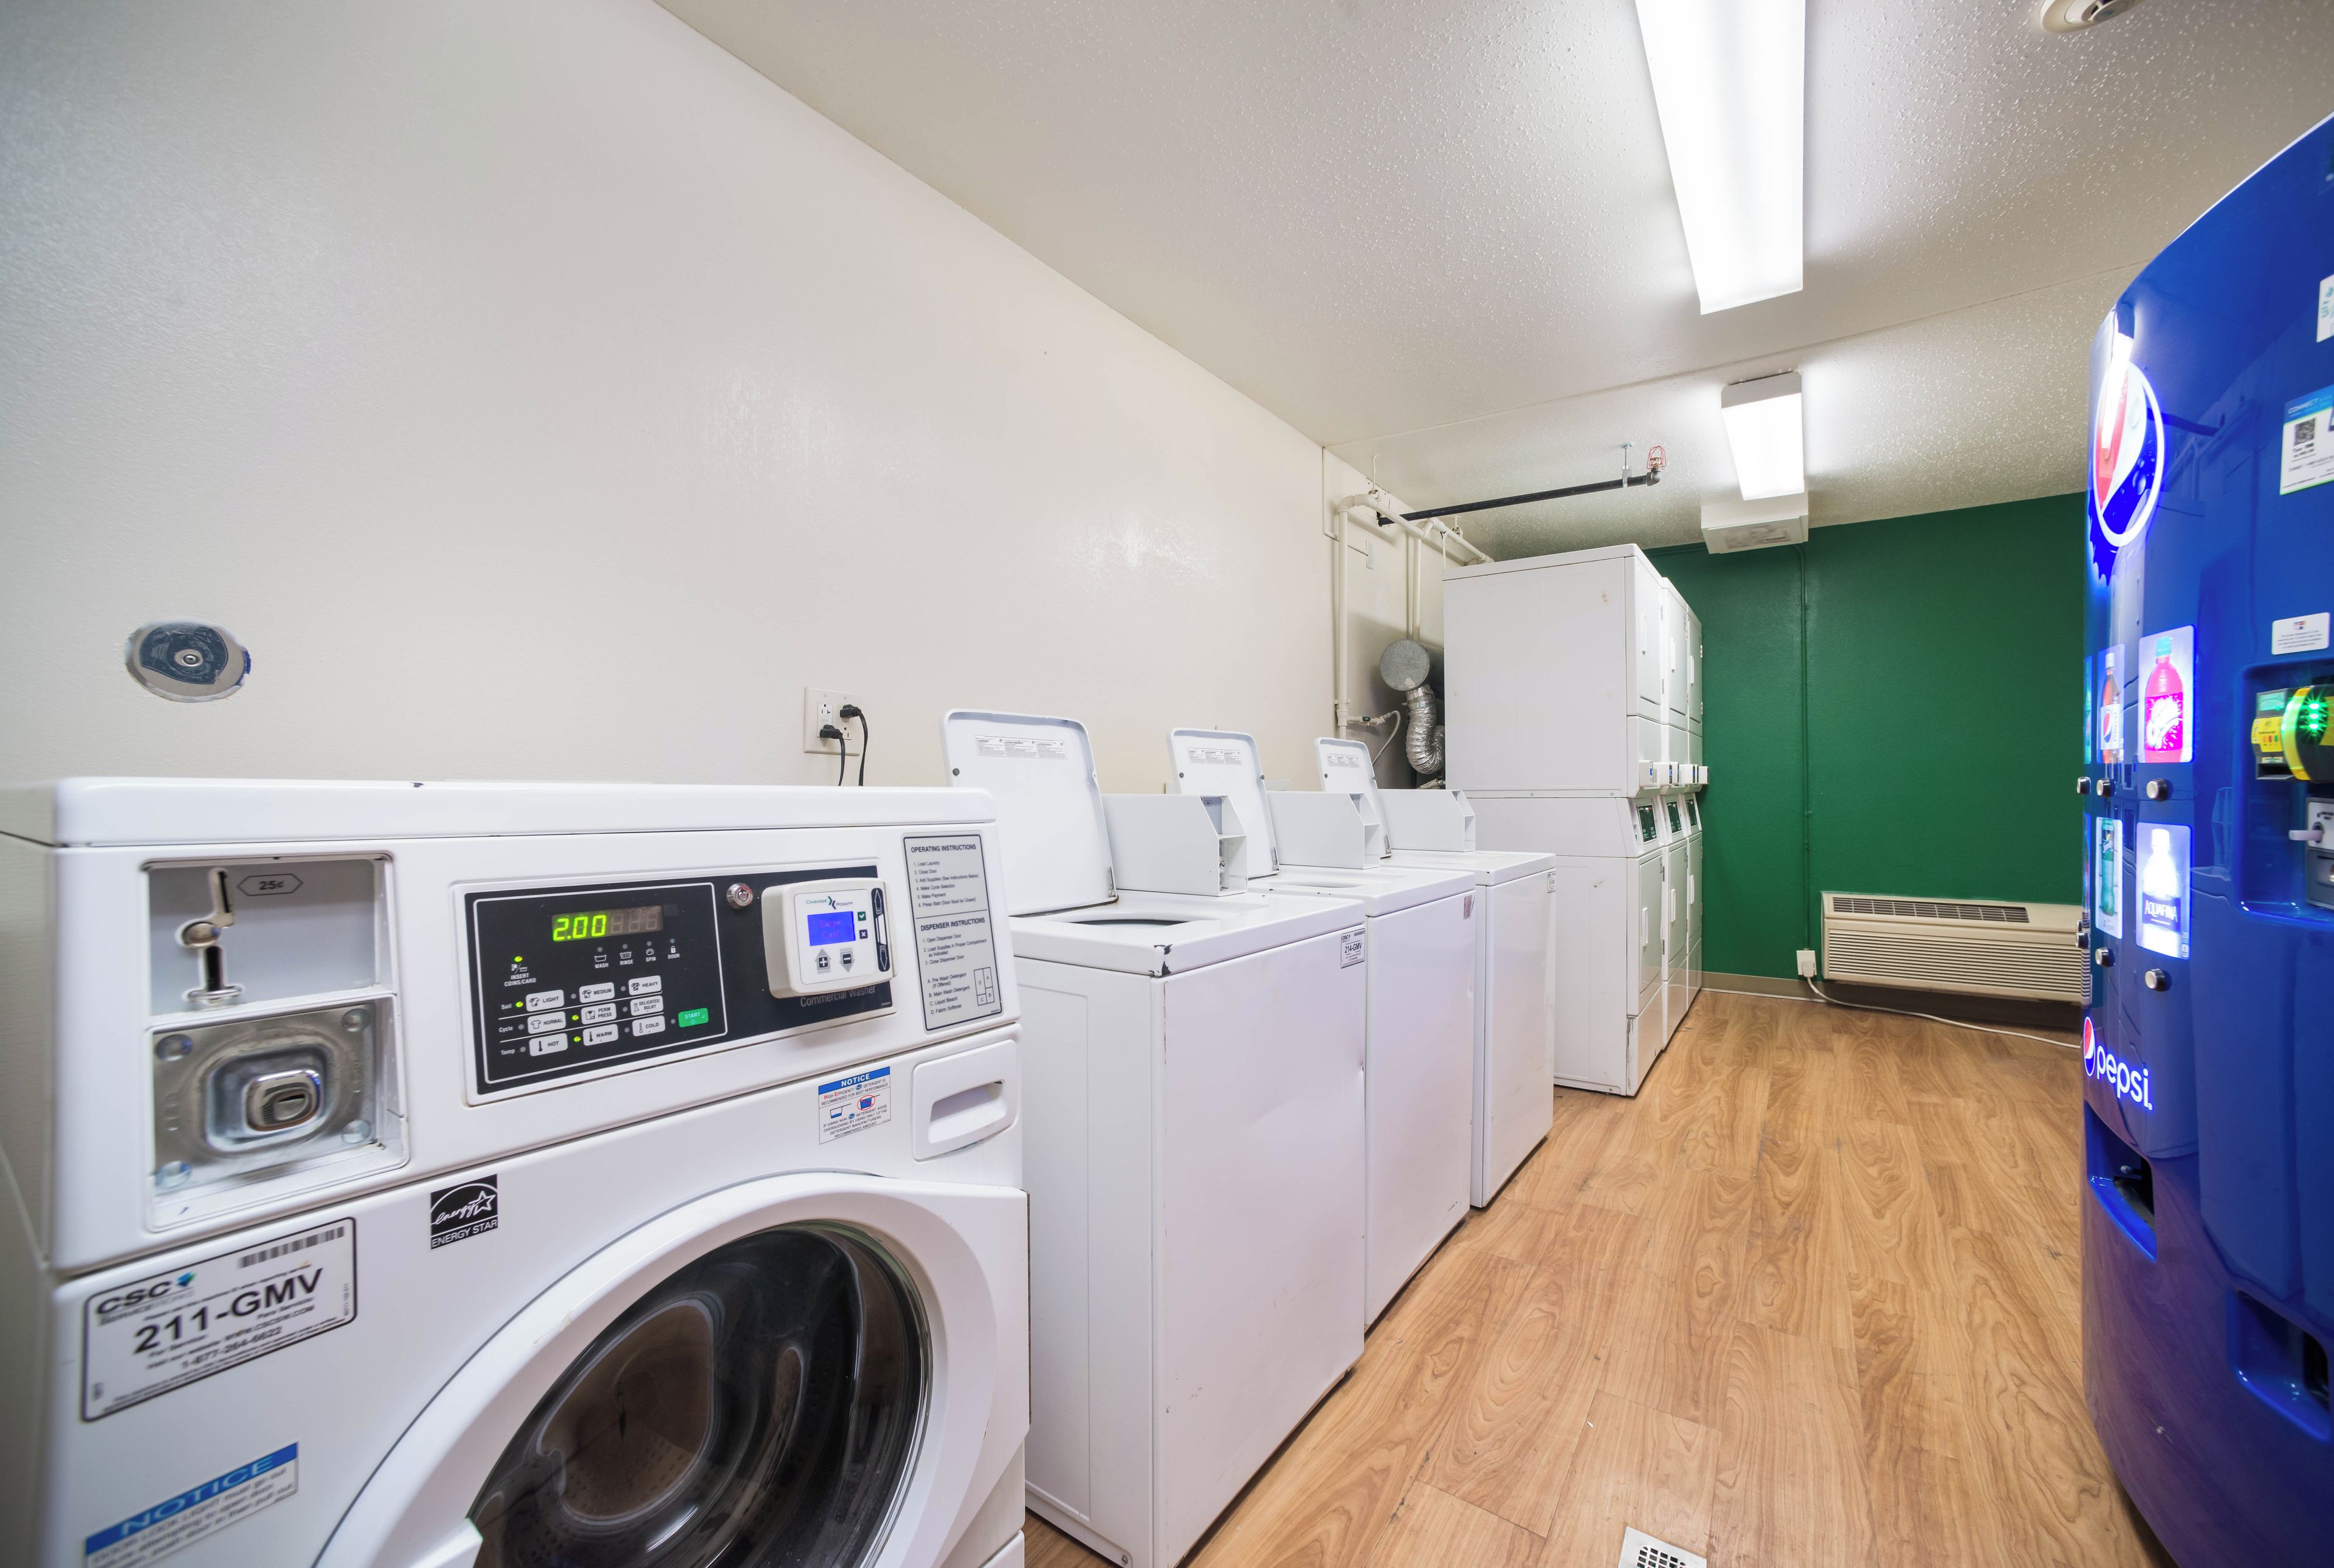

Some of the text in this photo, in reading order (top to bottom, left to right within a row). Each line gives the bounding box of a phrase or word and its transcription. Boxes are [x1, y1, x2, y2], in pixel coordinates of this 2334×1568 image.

[258, 880, 286, 890] 25¢
[2144, 900, 2178, 922] AQUAFINA
[552, 914, 607, 942] 2.00
[920, 917, 985, 931] DISPENSER INSTRUCTIONS
[1344, 942, 1362, 954] 214-GMV
[504, 978, 536, 986] COINS/CARD
[800, 986, 875, 1007] Commercial Washer
[841, 1073, 870, 1087] NOTICE
[2097, 1045, 2149, 1108] pepsi
[822, 1095, 847, 1106] RECOMMENDED
[864, 1083, 887, 1093] PERFORMANCE
[834, 1087, 853, 1096] EFFICIENCY
[830, 1125, 850, 1135] DETERGENT
[835, 1126, 861, 1138] RECOMMENDED
[432, 1220, 497, 1248] ENERGY STAR
[97, 1281, 173, 1315] CSC
[134, 1268, 323, 1354] 211-GMV
[122, 1456, 274, 1537] NOTICE
